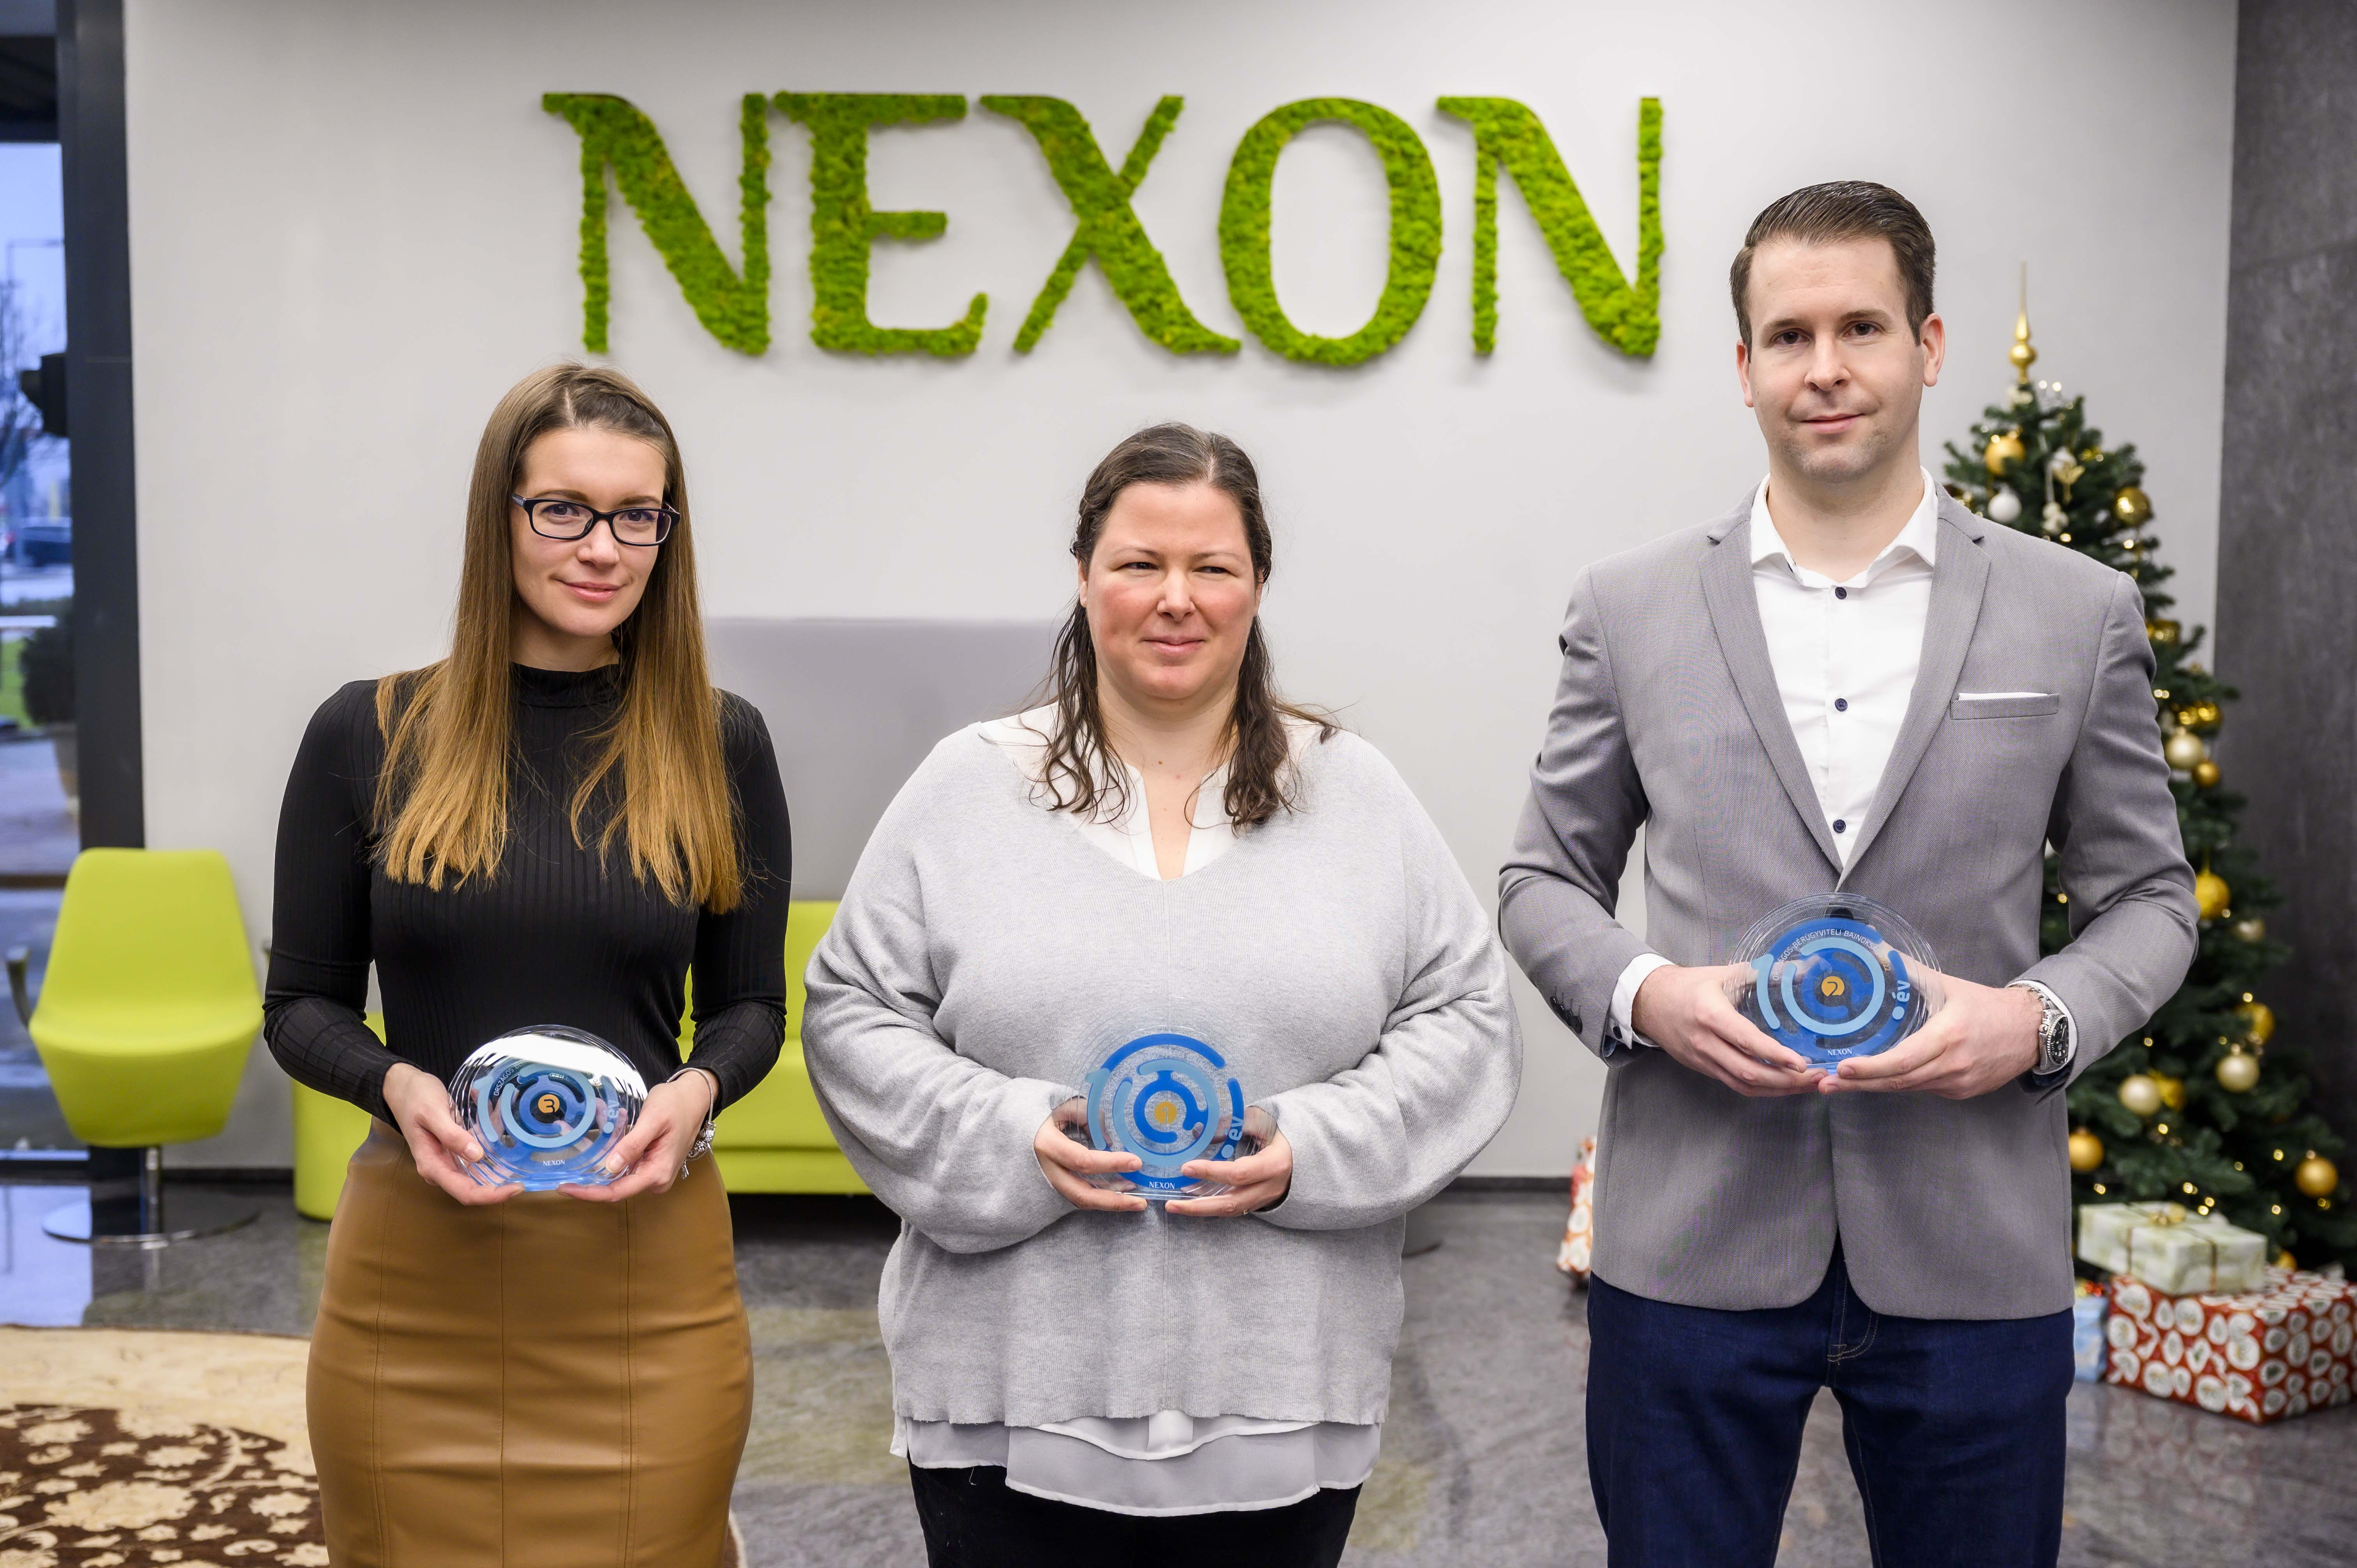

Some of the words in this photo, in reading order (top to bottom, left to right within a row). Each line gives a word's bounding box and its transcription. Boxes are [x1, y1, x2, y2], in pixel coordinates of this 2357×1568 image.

[543, 91, 1664, 366] NEXON
[1772, 947, 1793, 980] ORSZÁGOS
[1792, 929, 1841, 948] BÉRÜGYVITELI
[1879, 955, 1891, 972] 2022
[1827, 1048, 1852, 1056] NEXON
[493, 1068, 514, 1096] ORSZÁGOS
[1149, 1181, 1175, 1189] NEXON
